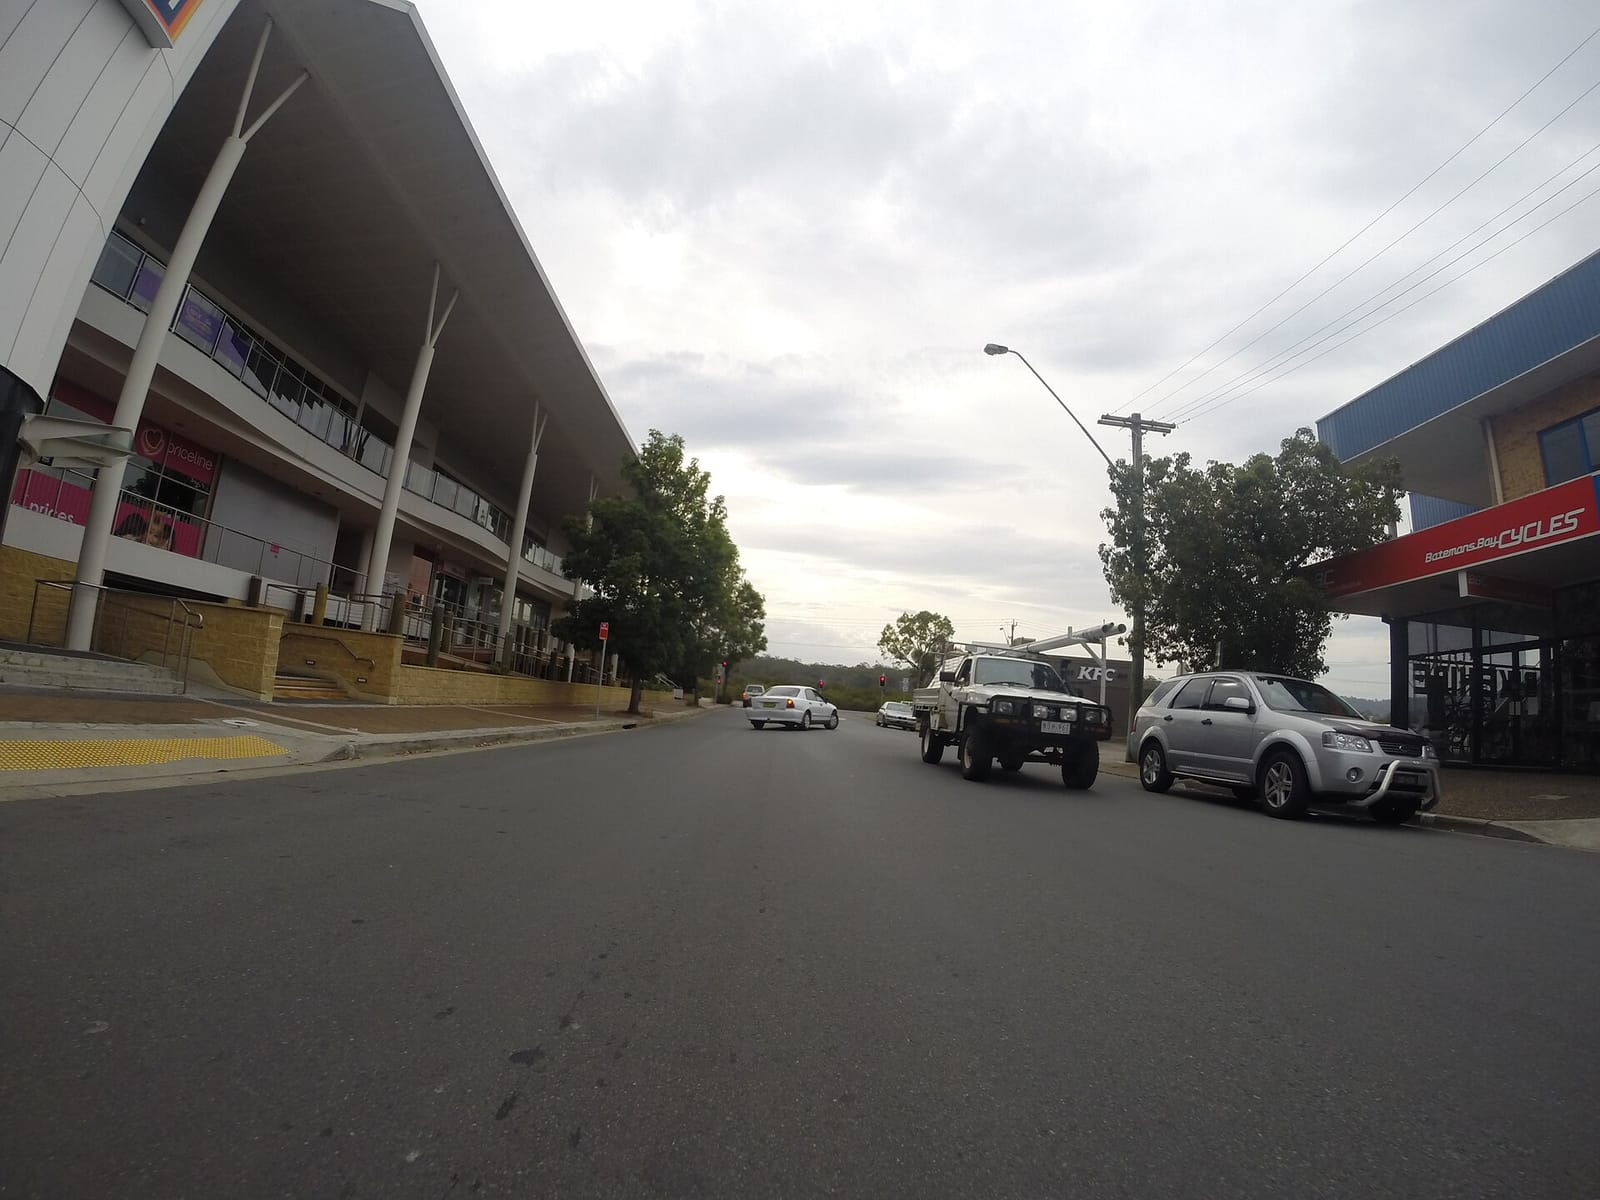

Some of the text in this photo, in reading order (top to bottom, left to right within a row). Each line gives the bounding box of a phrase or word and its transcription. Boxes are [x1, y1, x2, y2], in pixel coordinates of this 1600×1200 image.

[167, 442, 213, 470] priceline
[1425, 542, 1477, 563] Batemans
[1498, 507, 1585, 549] CYCLES
[1077, 666, 1116, 682] KFC
